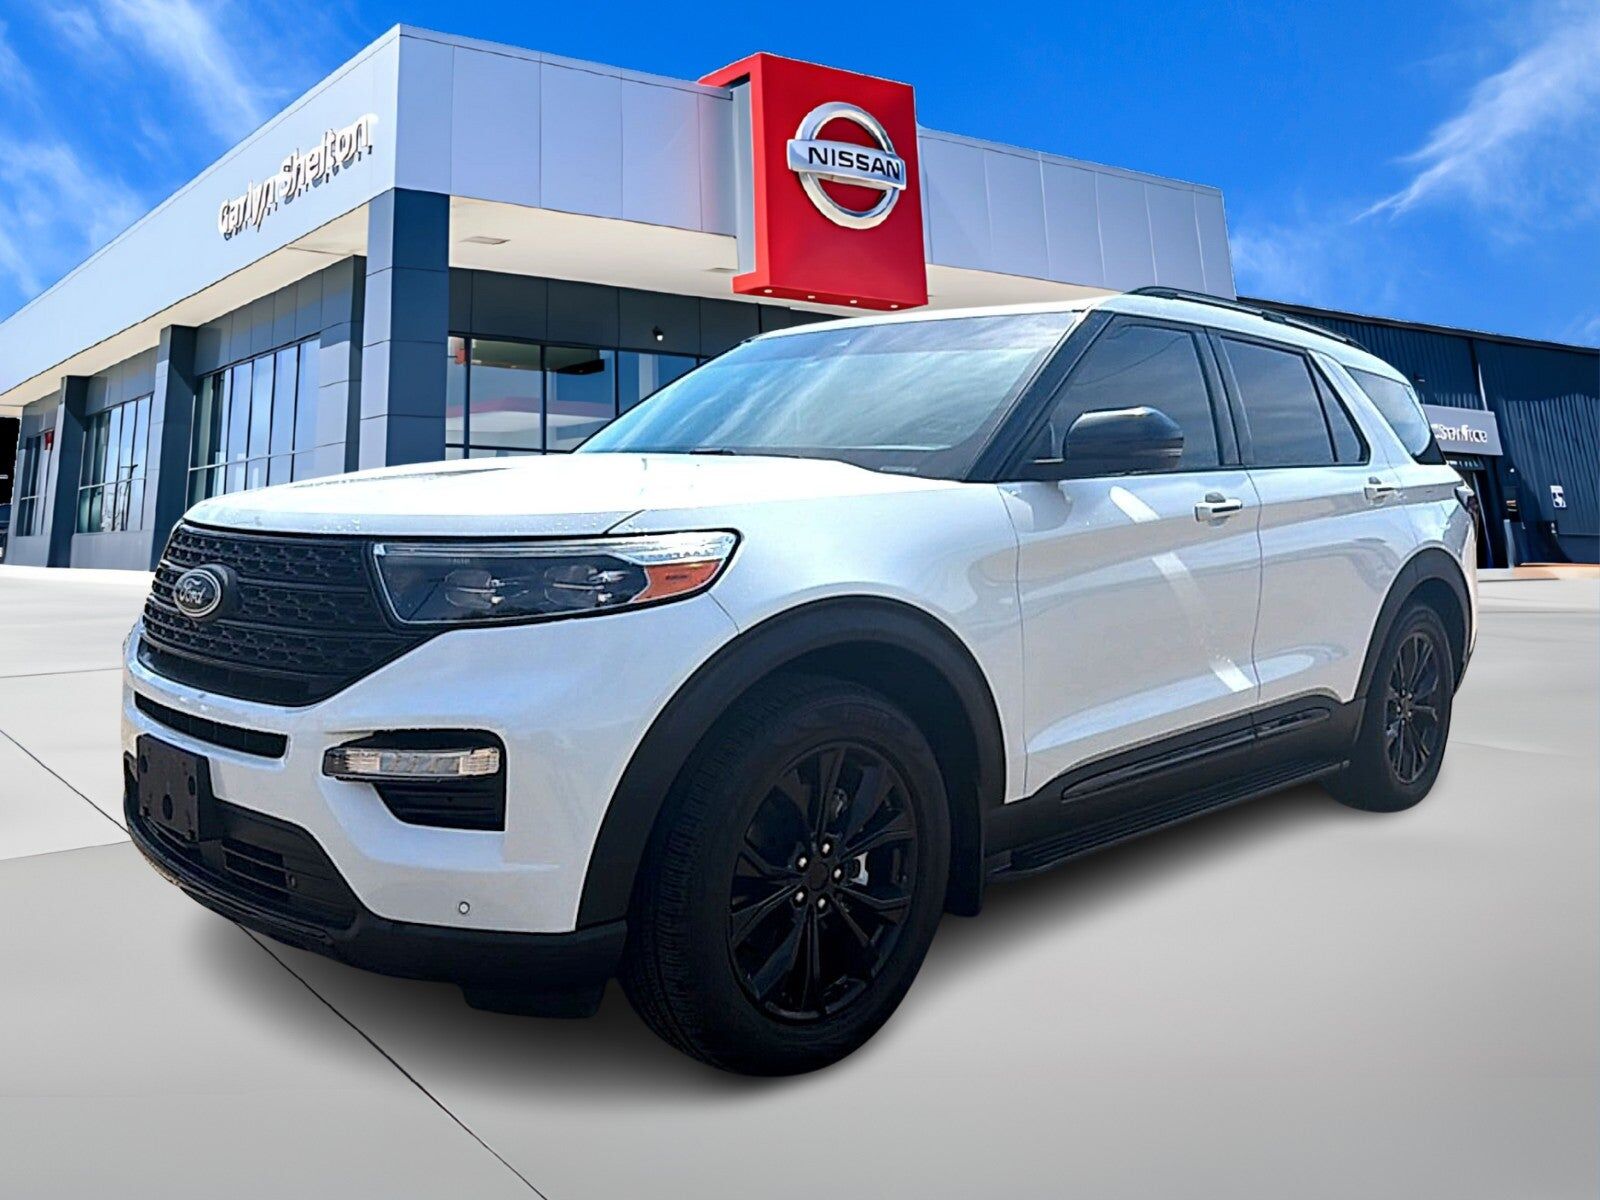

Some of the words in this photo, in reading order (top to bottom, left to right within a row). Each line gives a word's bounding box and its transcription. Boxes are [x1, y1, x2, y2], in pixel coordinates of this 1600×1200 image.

[280, 114, 375, 203] Shelton
[808, 147, 900, 180] NISSAN
[178, 577, 207, 605] Ford
